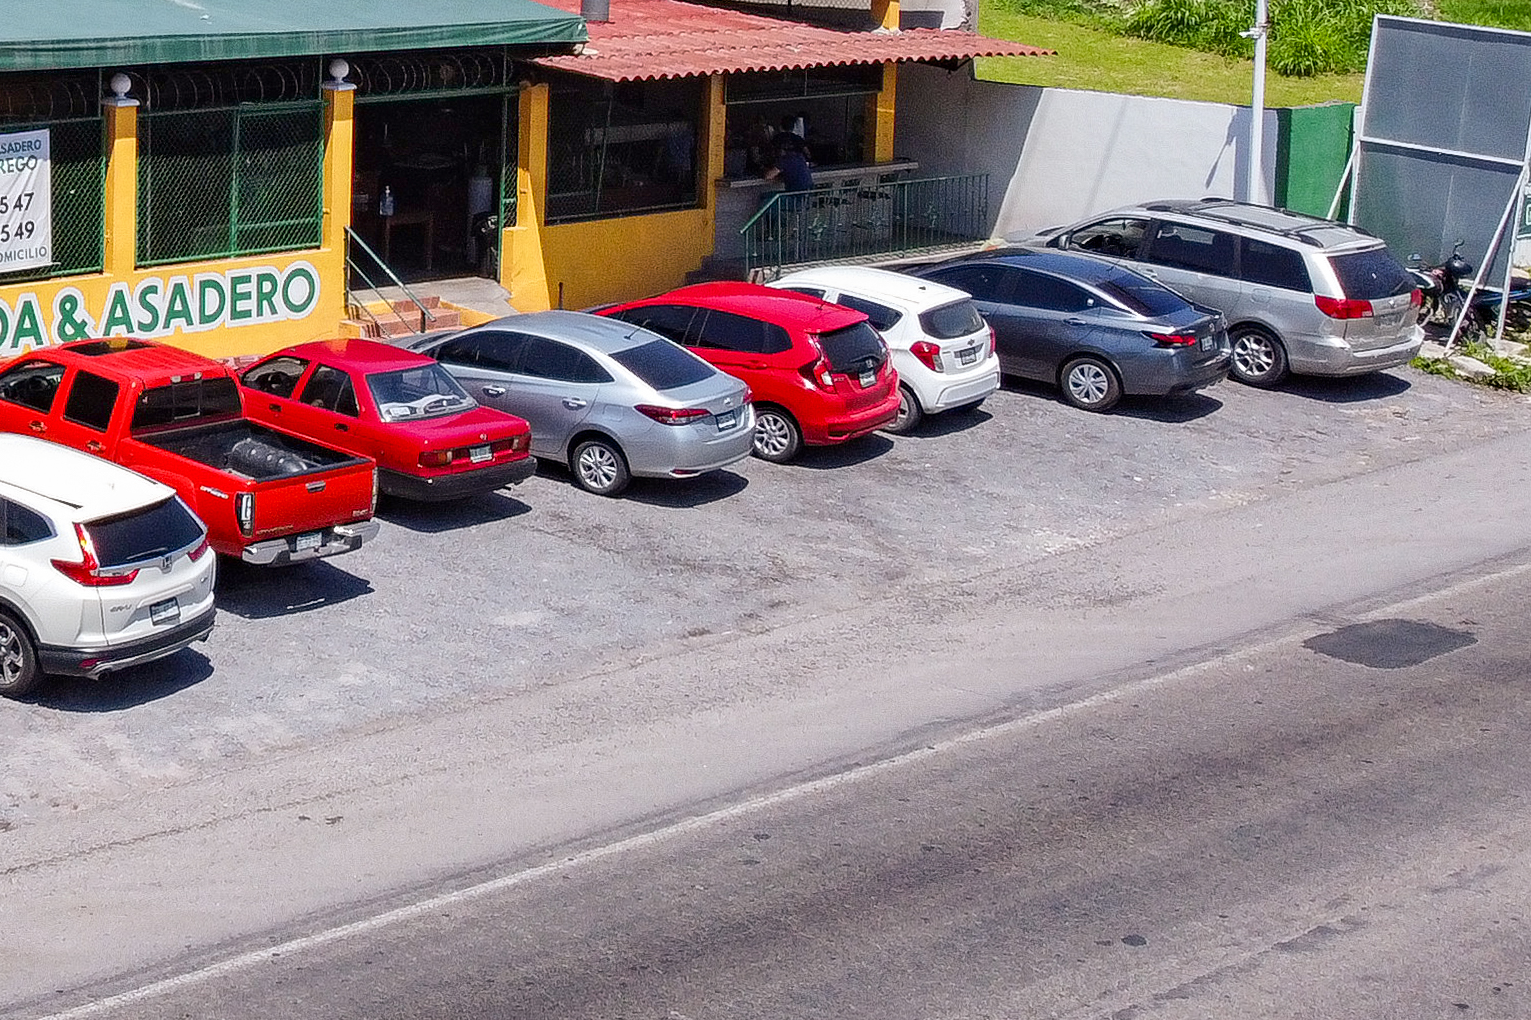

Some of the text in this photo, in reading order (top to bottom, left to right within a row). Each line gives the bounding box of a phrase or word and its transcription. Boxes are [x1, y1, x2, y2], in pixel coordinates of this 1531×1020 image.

[13, 192, 34, 213] 47
[14, 221, 35, 240] 49
[57, 292, 88, 342] &
[104, 267, 316, 337] ASADERO
